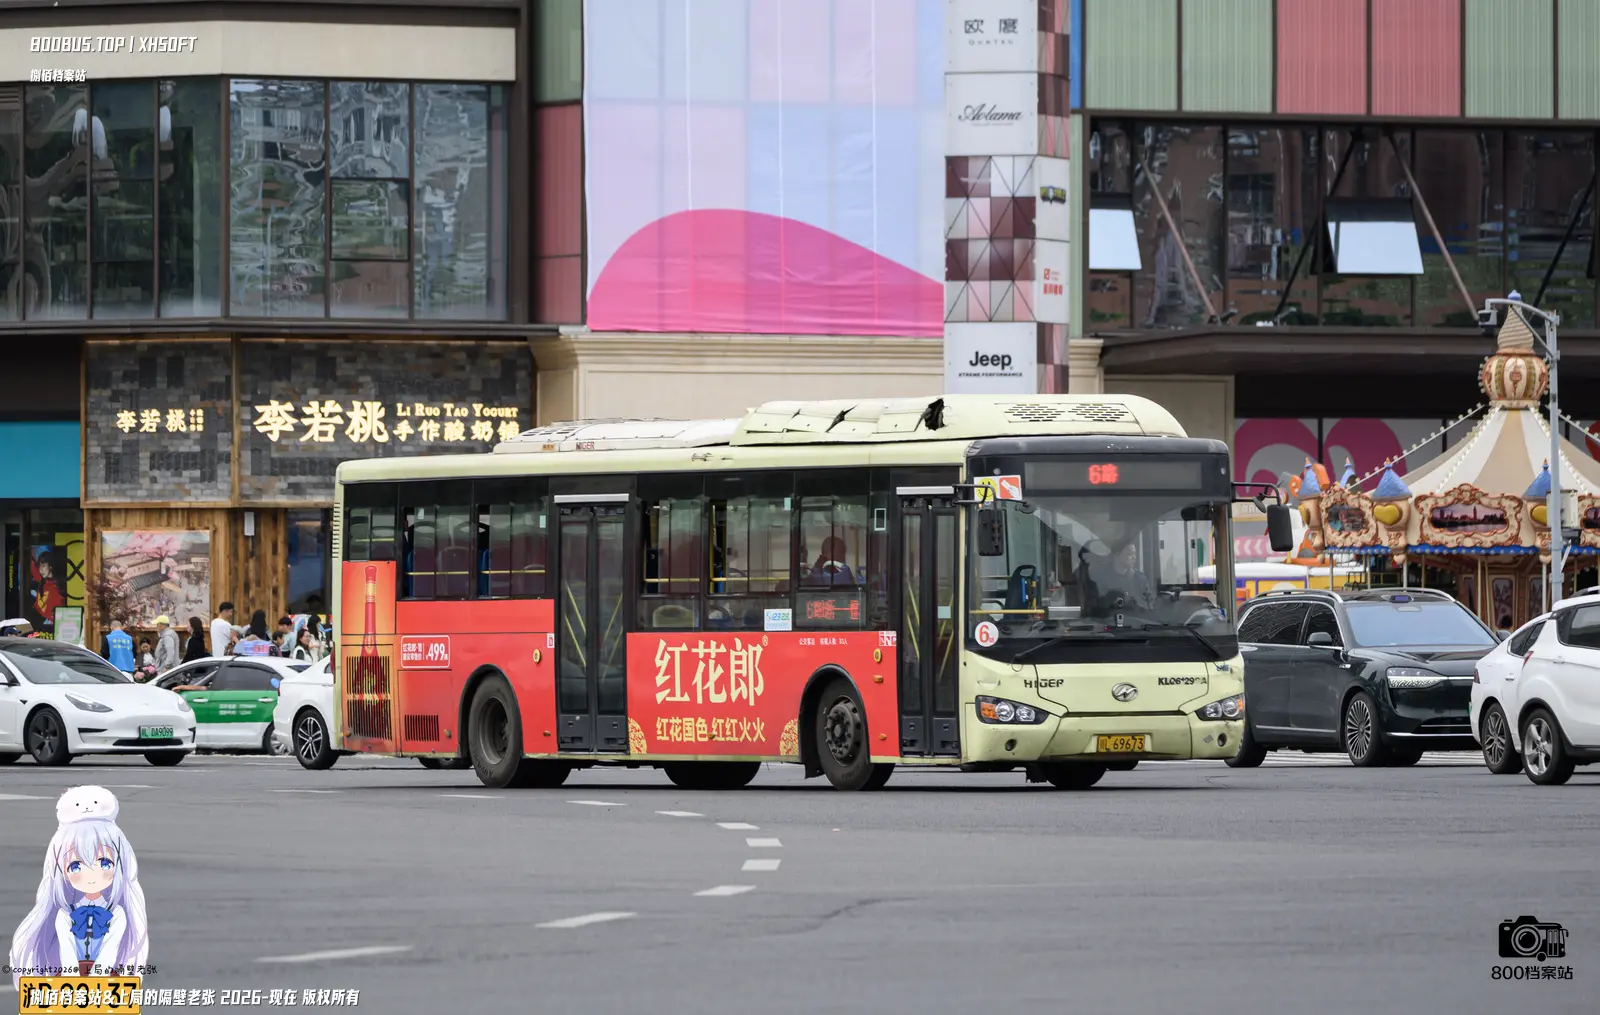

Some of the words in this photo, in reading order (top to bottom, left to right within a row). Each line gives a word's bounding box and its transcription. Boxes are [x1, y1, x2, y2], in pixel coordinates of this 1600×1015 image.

[969, 351, 1013, 370] Jeep
[116, 409, 187, 433] 李若桃
[253, 400, 390, 443] 李若桃
